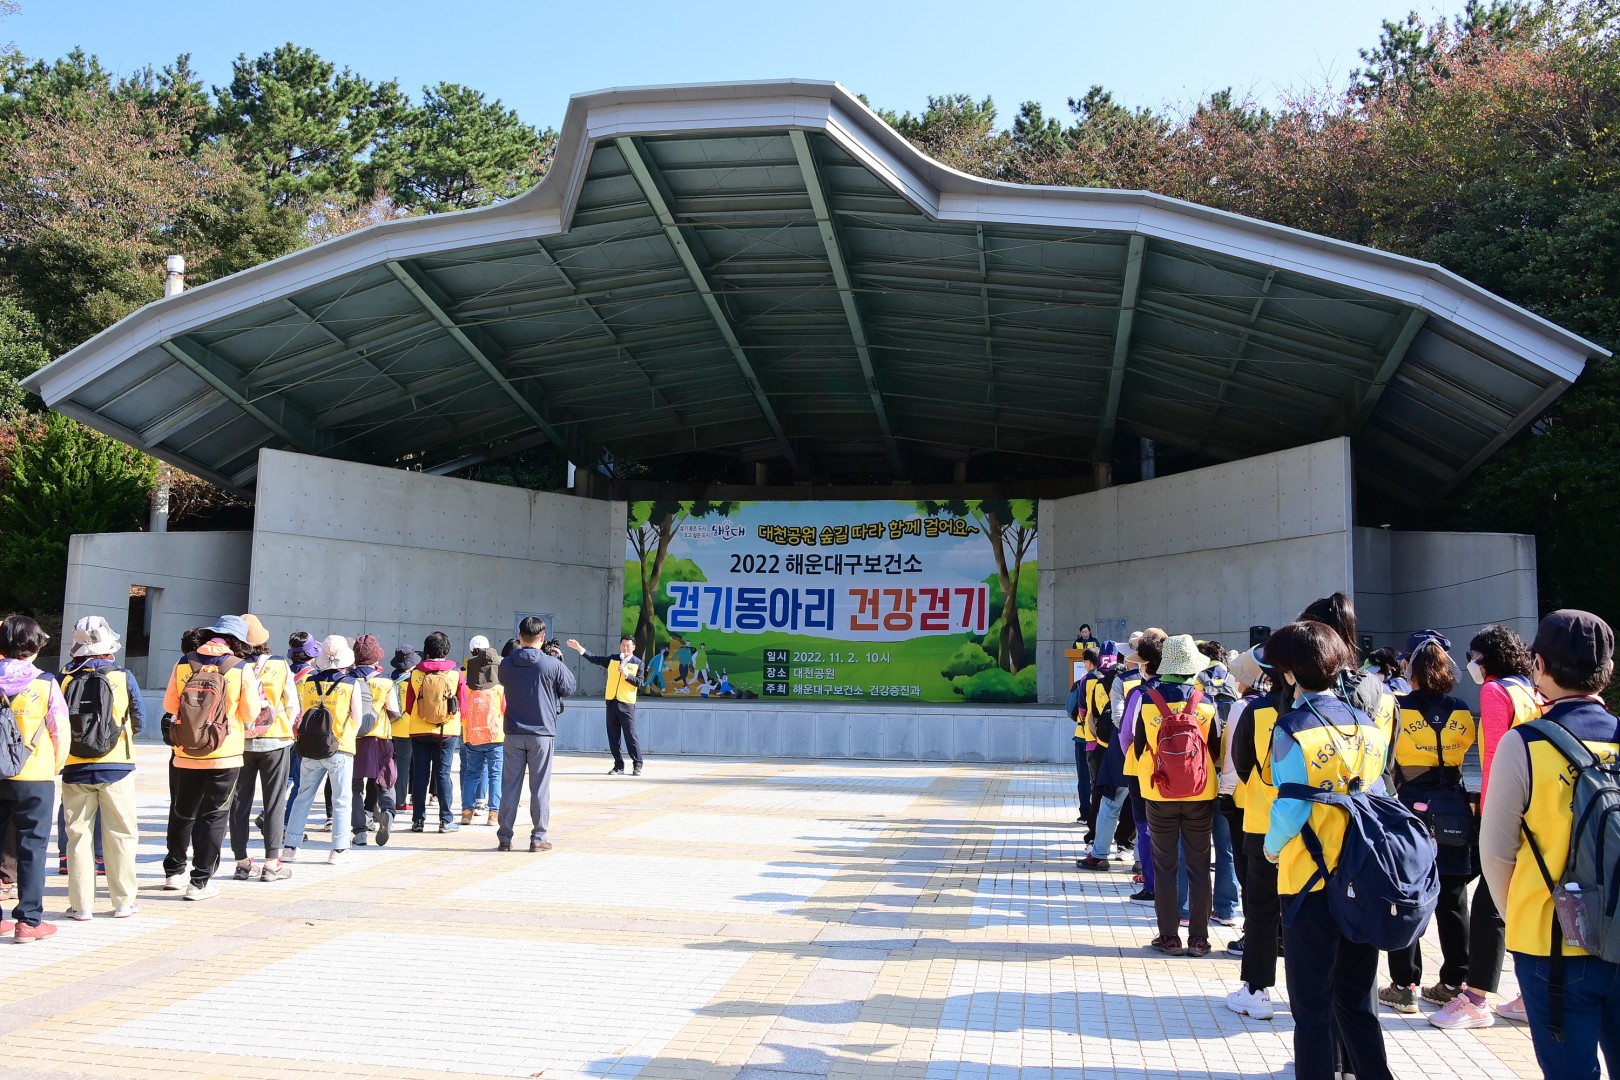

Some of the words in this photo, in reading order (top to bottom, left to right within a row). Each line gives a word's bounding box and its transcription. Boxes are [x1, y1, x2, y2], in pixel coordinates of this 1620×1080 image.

[712, 525, 745, 540] 해운대
[758, 525, 816, 545] 대천공원
[820, 525, 849, 545] 숲길
[851, 522, 885, 540] 따라
[889, 518, 921, 539] 함께
[924, 518, 979, 537] 걸어요~
[730, 553, 780, 573] 2022
[785, 553, 923, 576] 해운대구보건소
[670, 586, 835, 631] 걷기동아리
[848, 587, 986, 631] 건강걷기
[767, 652, 787, 662] 일시
[793, 652, 825, 663] 2022.
[829, 652, 844, 663] 11.
[848, 652, 859, 663] 2.
[866, 652, 891, 663] 10시
[766, 668, 787, 678] 장소
[793, 668, 836, 679] 대천공원
[766, 684, 786, 694] 주최
[793, 684, 864, 696] 해운대구보건소
[870, 685, 921, 697] 건강증진과
